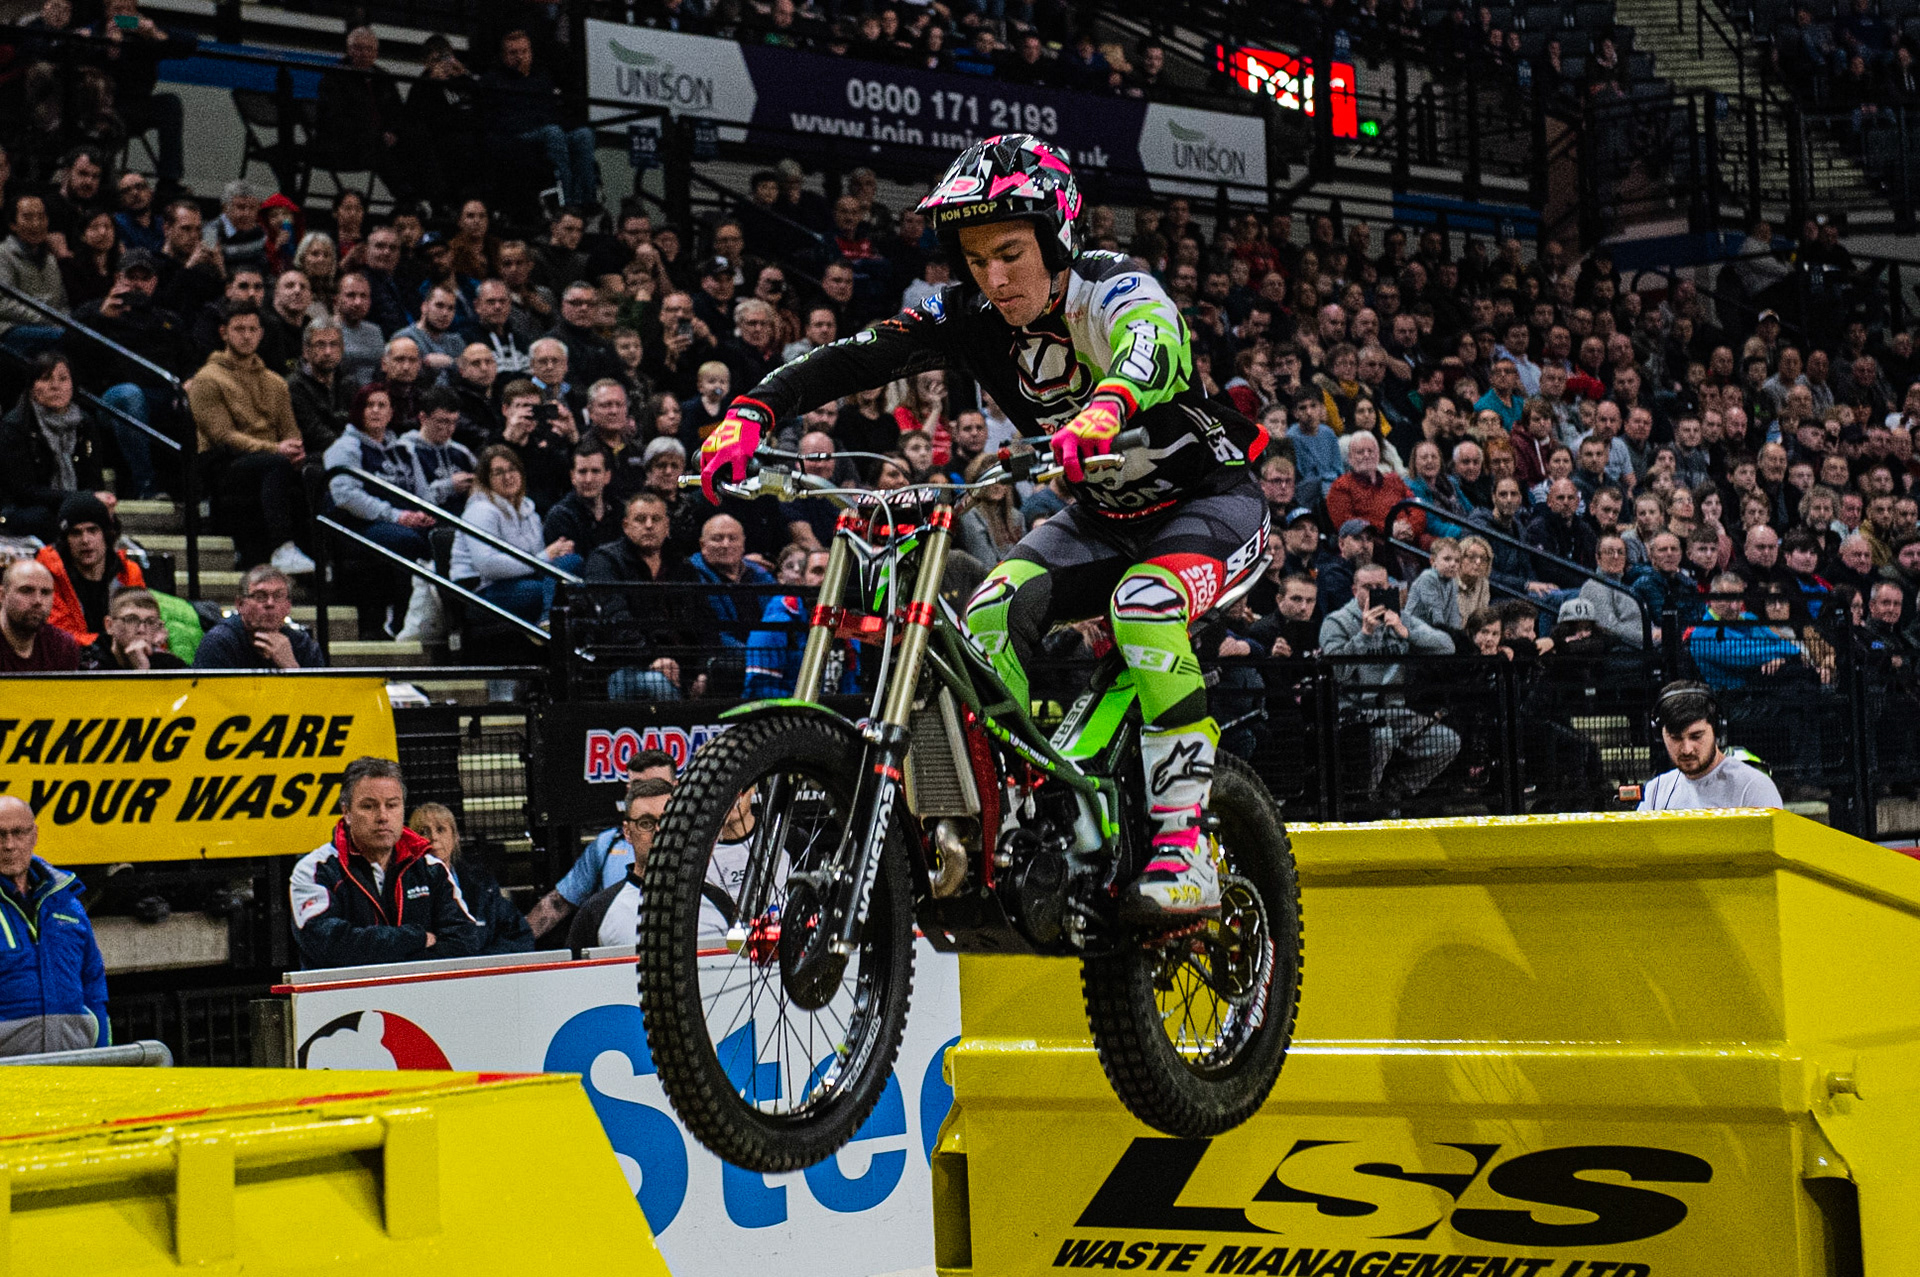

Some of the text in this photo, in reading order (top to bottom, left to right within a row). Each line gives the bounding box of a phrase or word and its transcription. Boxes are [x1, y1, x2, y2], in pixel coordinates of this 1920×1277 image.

[616, 65, 713, 105] UNISON
[846, 78, 1058, 135] 0800 171 2193
[1173, 142, 1246, 178] UNISON
[940, 201, 998, 222] NON STOP
[0, 715, 354, 764] TAKING CARE
[31, 772, 346, 826] YOUR WAST
[1073, 1137, 1713, 1248] LSS
[1052, 1239, 1207, 1272] WASTE
[1205, 1245, 1556, 1277] MANAGEMENT
